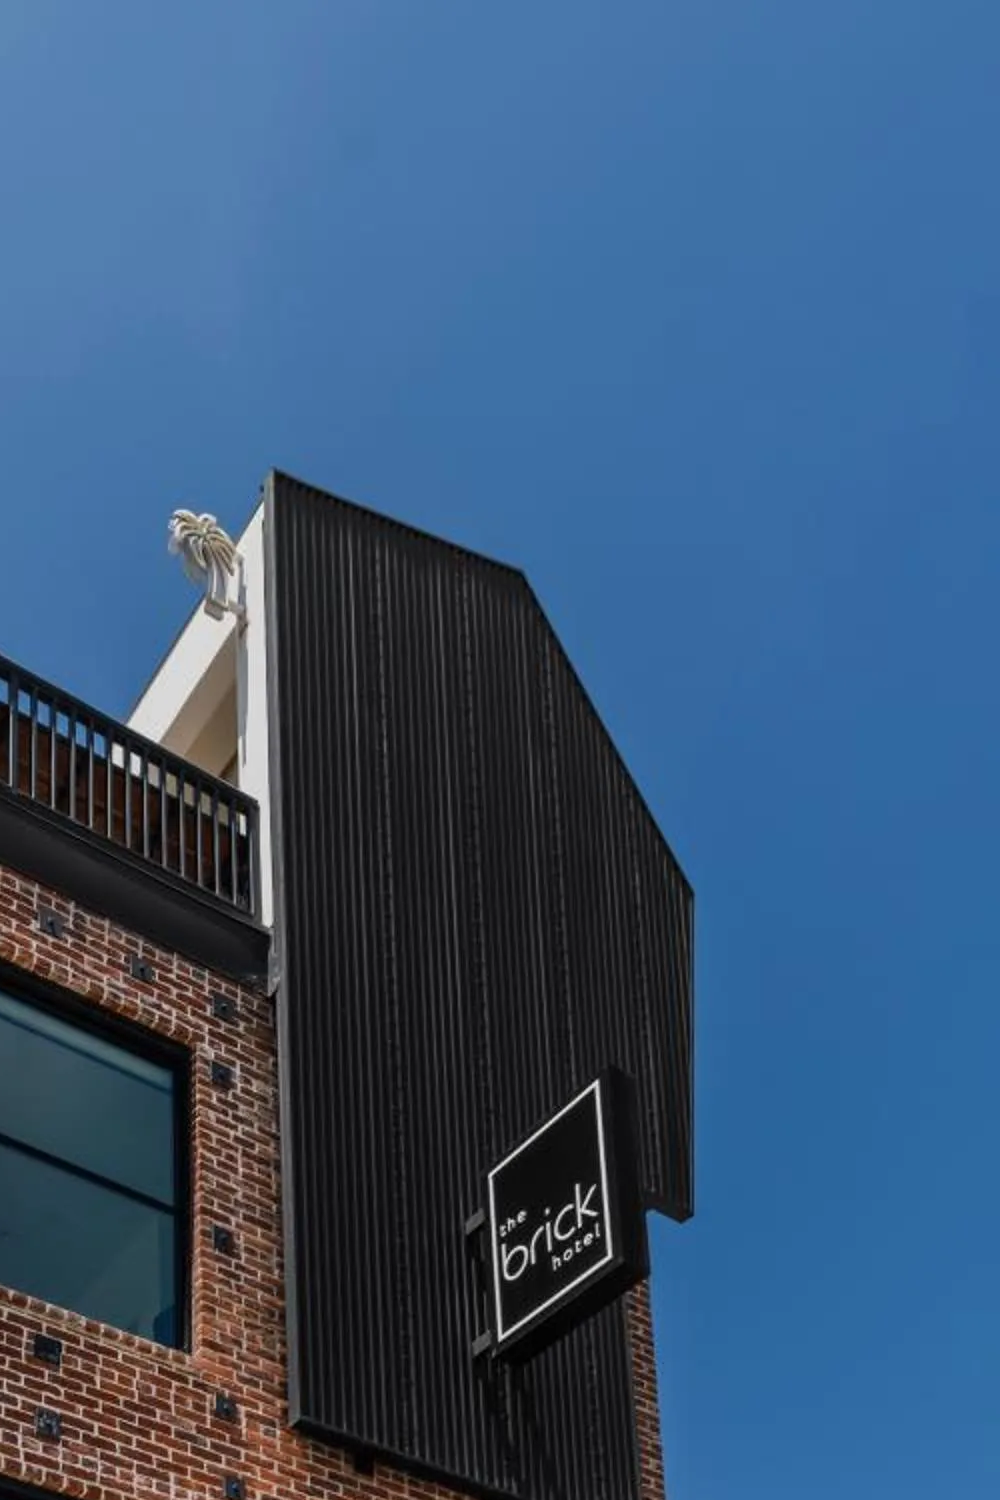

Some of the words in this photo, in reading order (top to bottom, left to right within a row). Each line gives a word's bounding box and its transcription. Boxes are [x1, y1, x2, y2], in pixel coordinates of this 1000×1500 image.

[500, 1210, 527, 1237] the
[501, 1183, 599, 1281] brick
[552, 1222, 600, 1271] hotel
